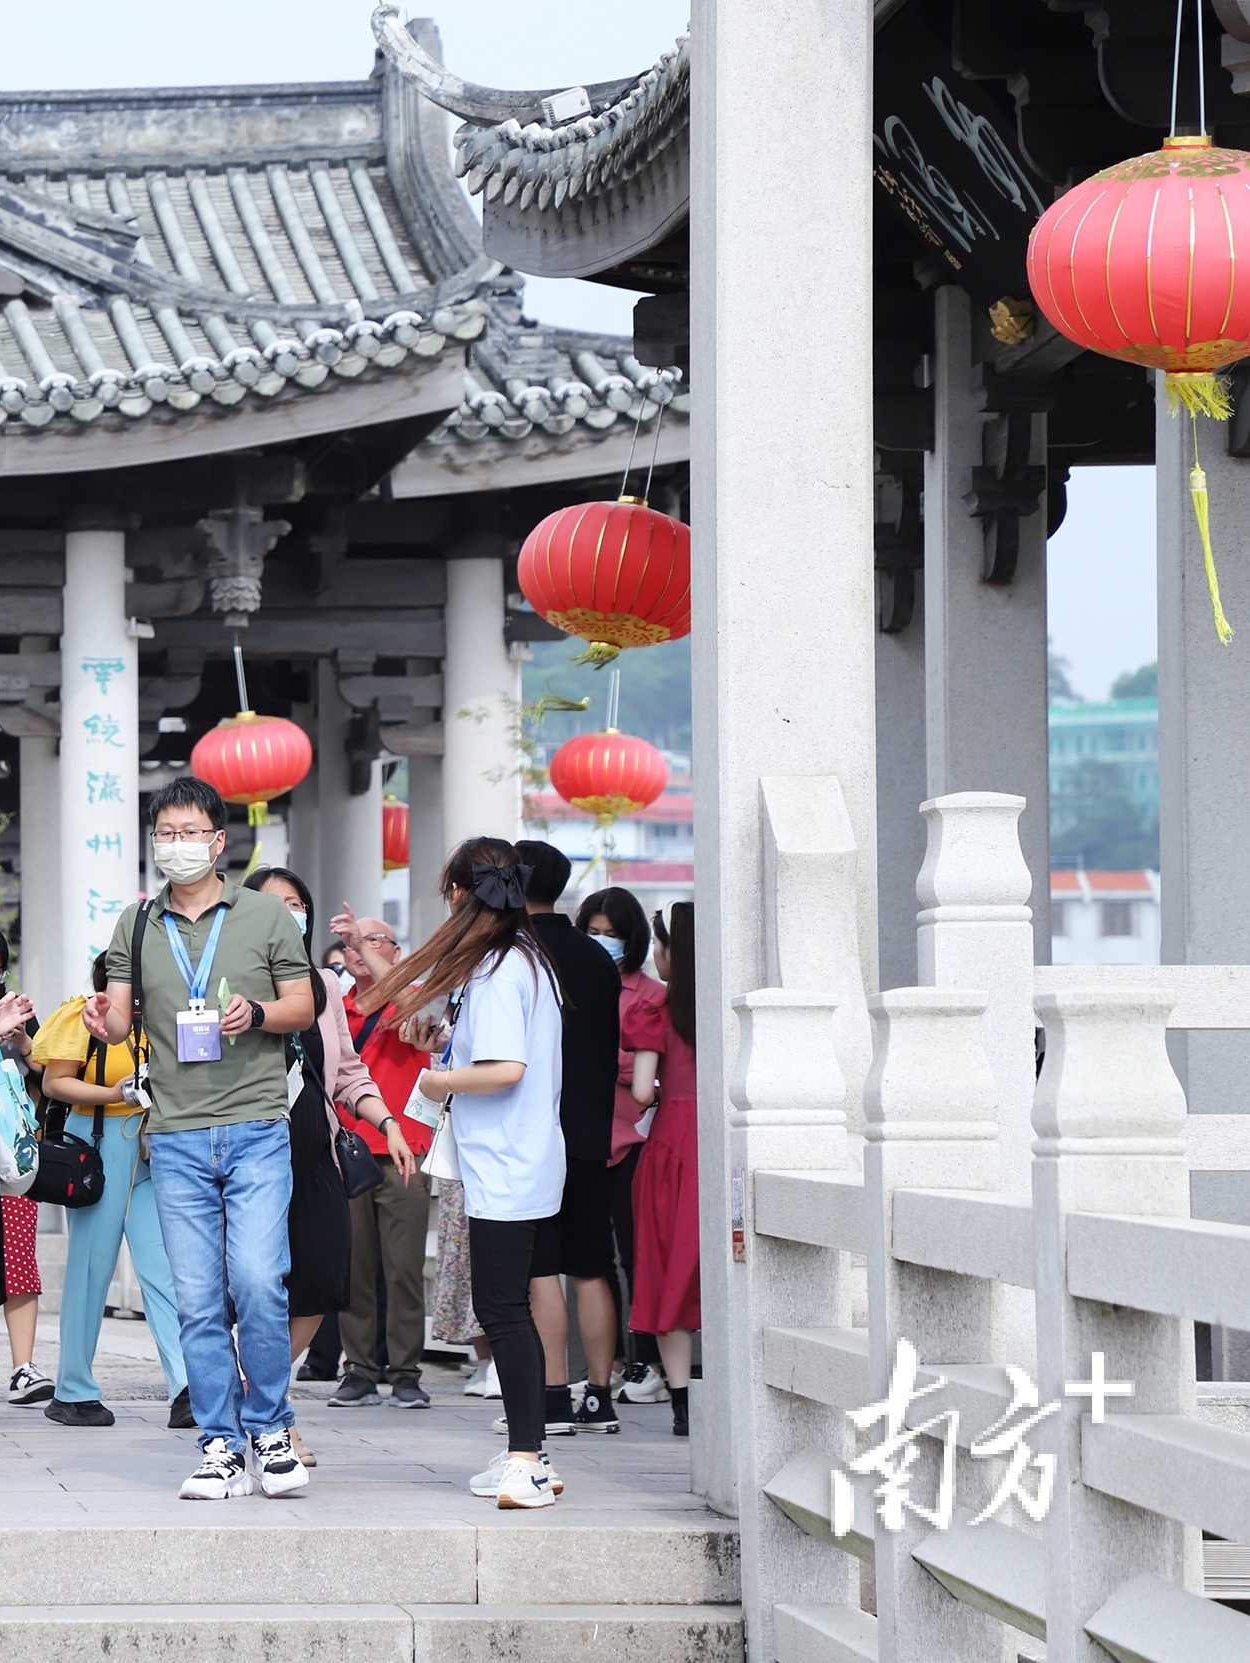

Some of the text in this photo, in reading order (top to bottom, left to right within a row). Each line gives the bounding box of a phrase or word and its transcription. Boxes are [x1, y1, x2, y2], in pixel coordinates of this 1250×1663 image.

[81, 656, 127, 965] 雲繞瀛州江
